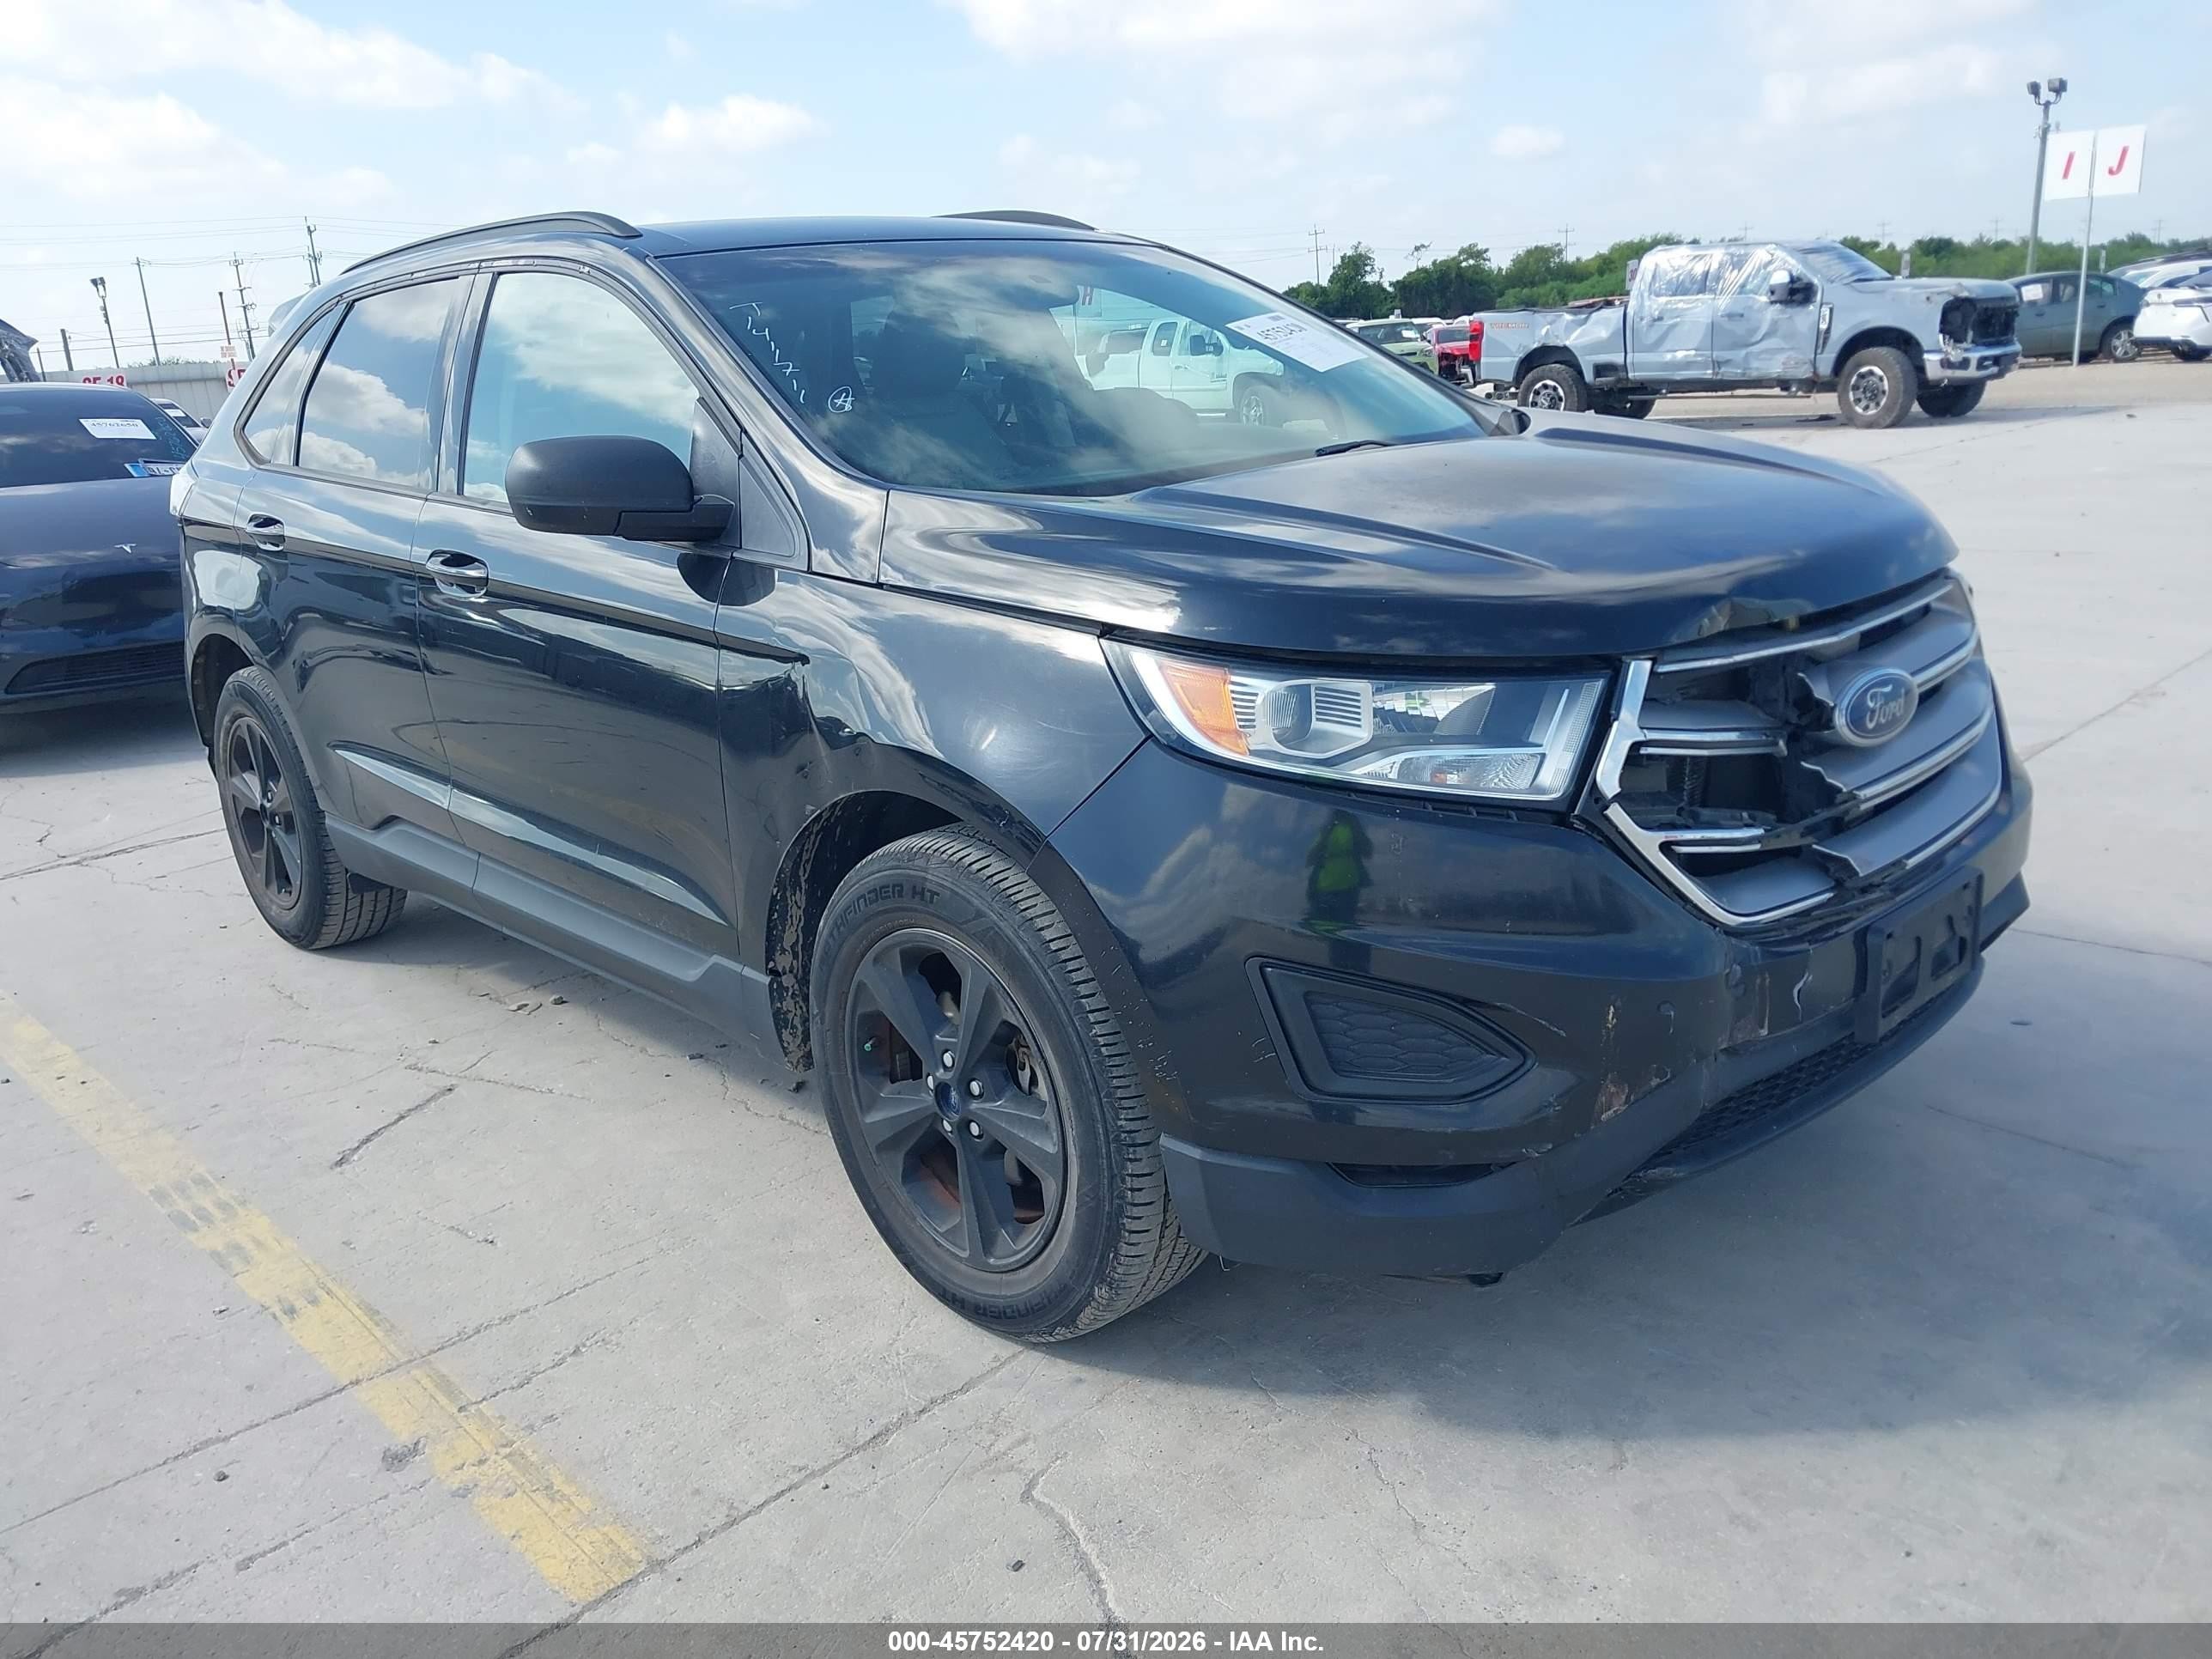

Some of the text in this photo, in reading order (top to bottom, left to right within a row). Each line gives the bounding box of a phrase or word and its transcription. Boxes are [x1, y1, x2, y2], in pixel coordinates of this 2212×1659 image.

[2062, 151, 2076, 179] I
[2108, 145, 2130, 176] J
[1866, 684, 1905, 729] Ford
